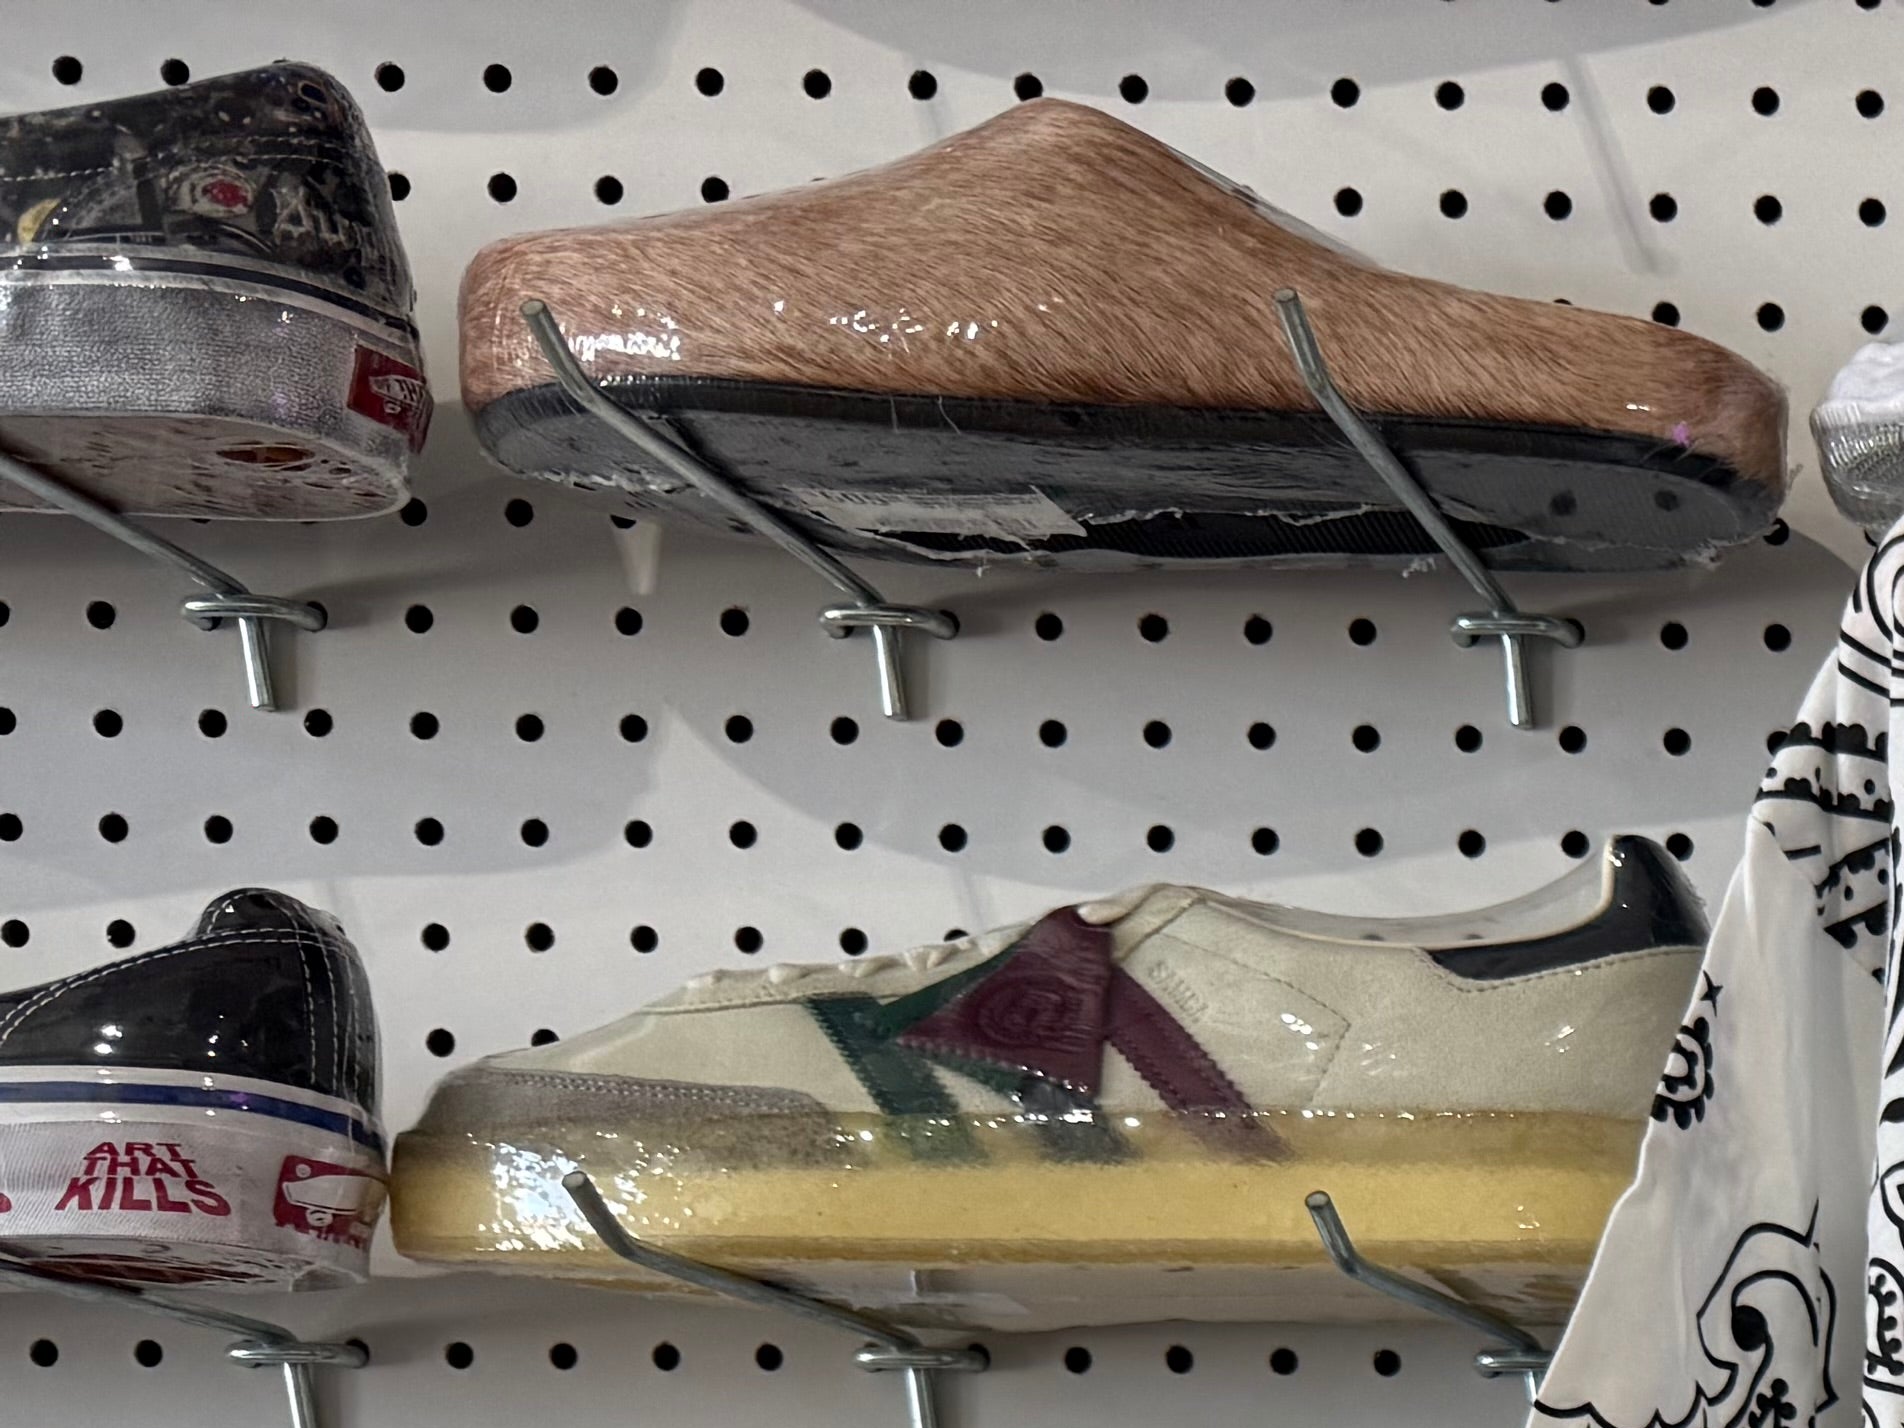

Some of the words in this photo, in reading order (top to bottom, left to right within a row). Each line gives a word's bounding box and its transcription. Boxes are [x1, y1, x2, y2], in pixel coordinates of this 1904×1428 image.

[82, 1141, 182, 1160] ART
[82, 1156, 200, 1180] THAT
[54, 1176, 232, 1217] KILLS
